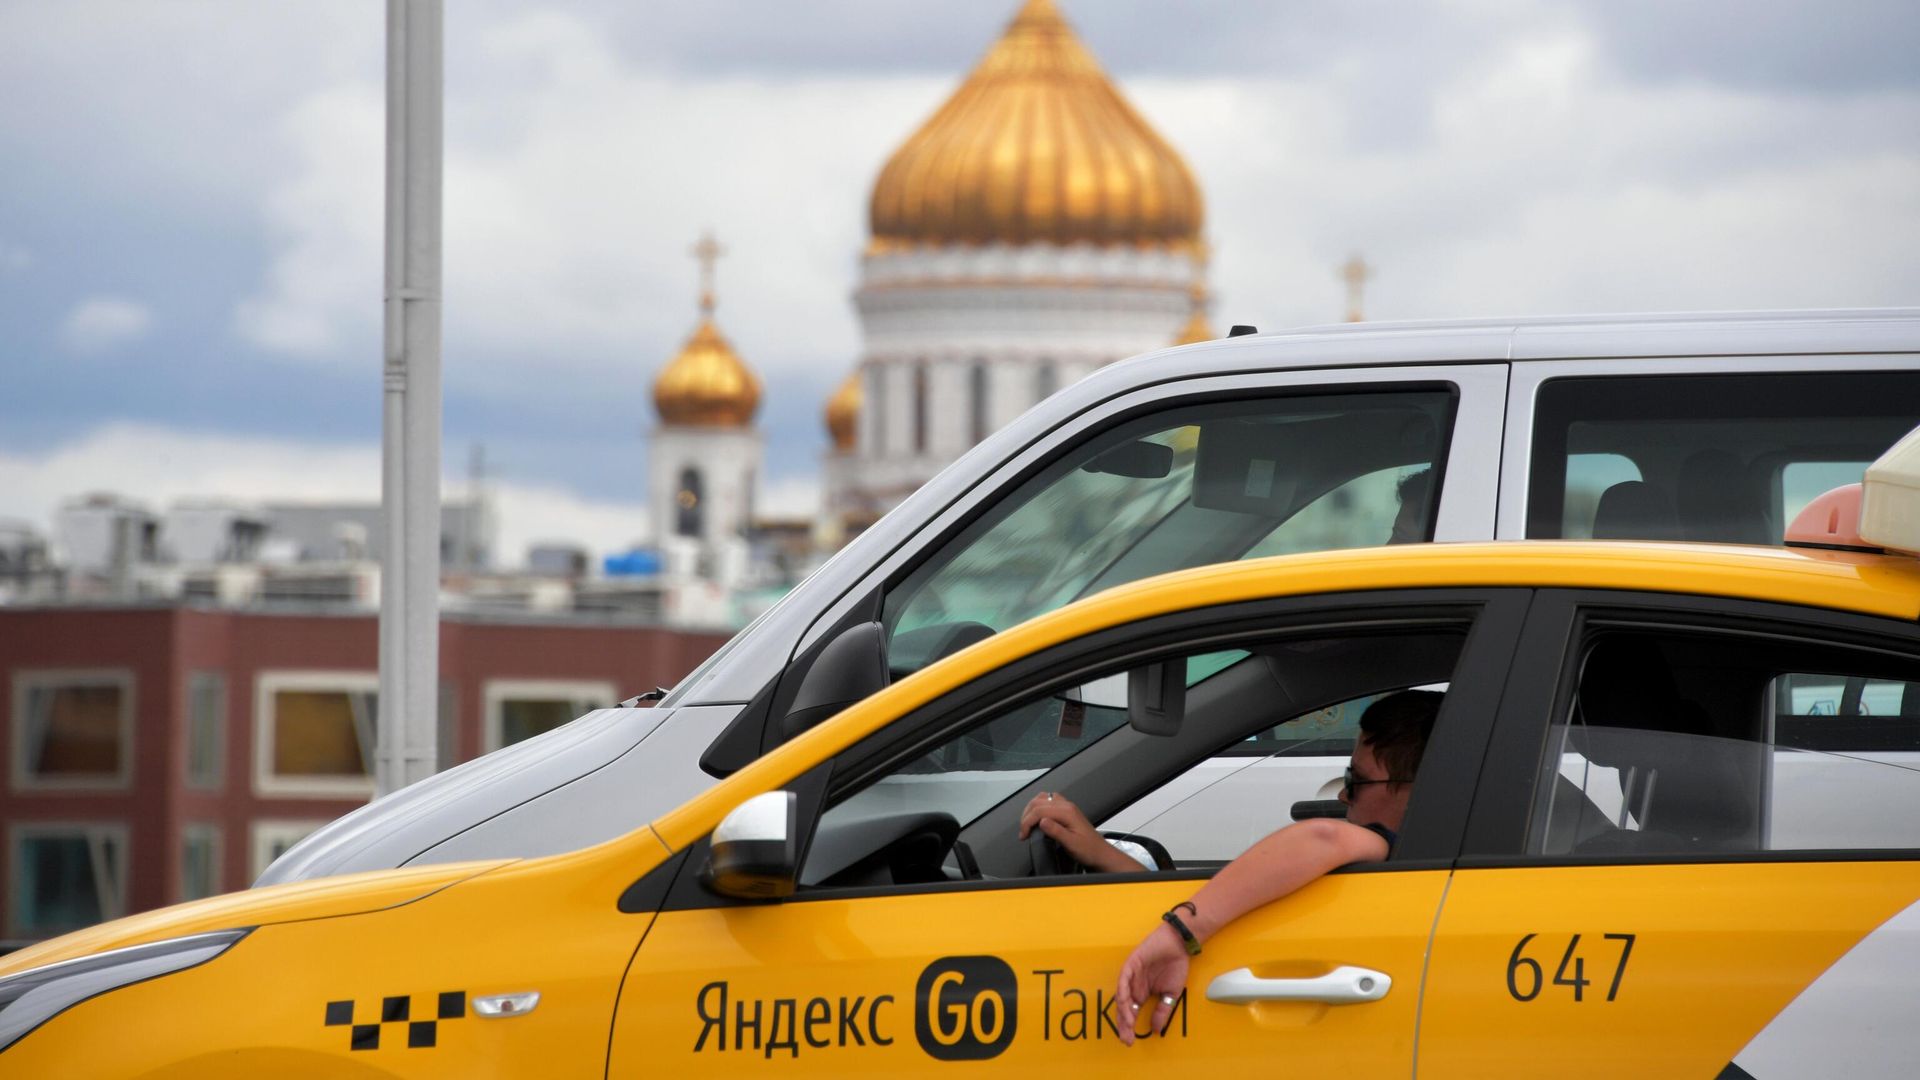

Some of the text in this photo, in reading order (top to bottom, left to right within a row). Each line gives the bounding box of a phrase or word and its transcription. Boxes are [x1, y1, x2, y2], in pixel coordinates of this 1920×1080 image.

[1506, 933, 1636, 1002] 647
[694, 969, 1188, 1059] Яндекс Go Таки
